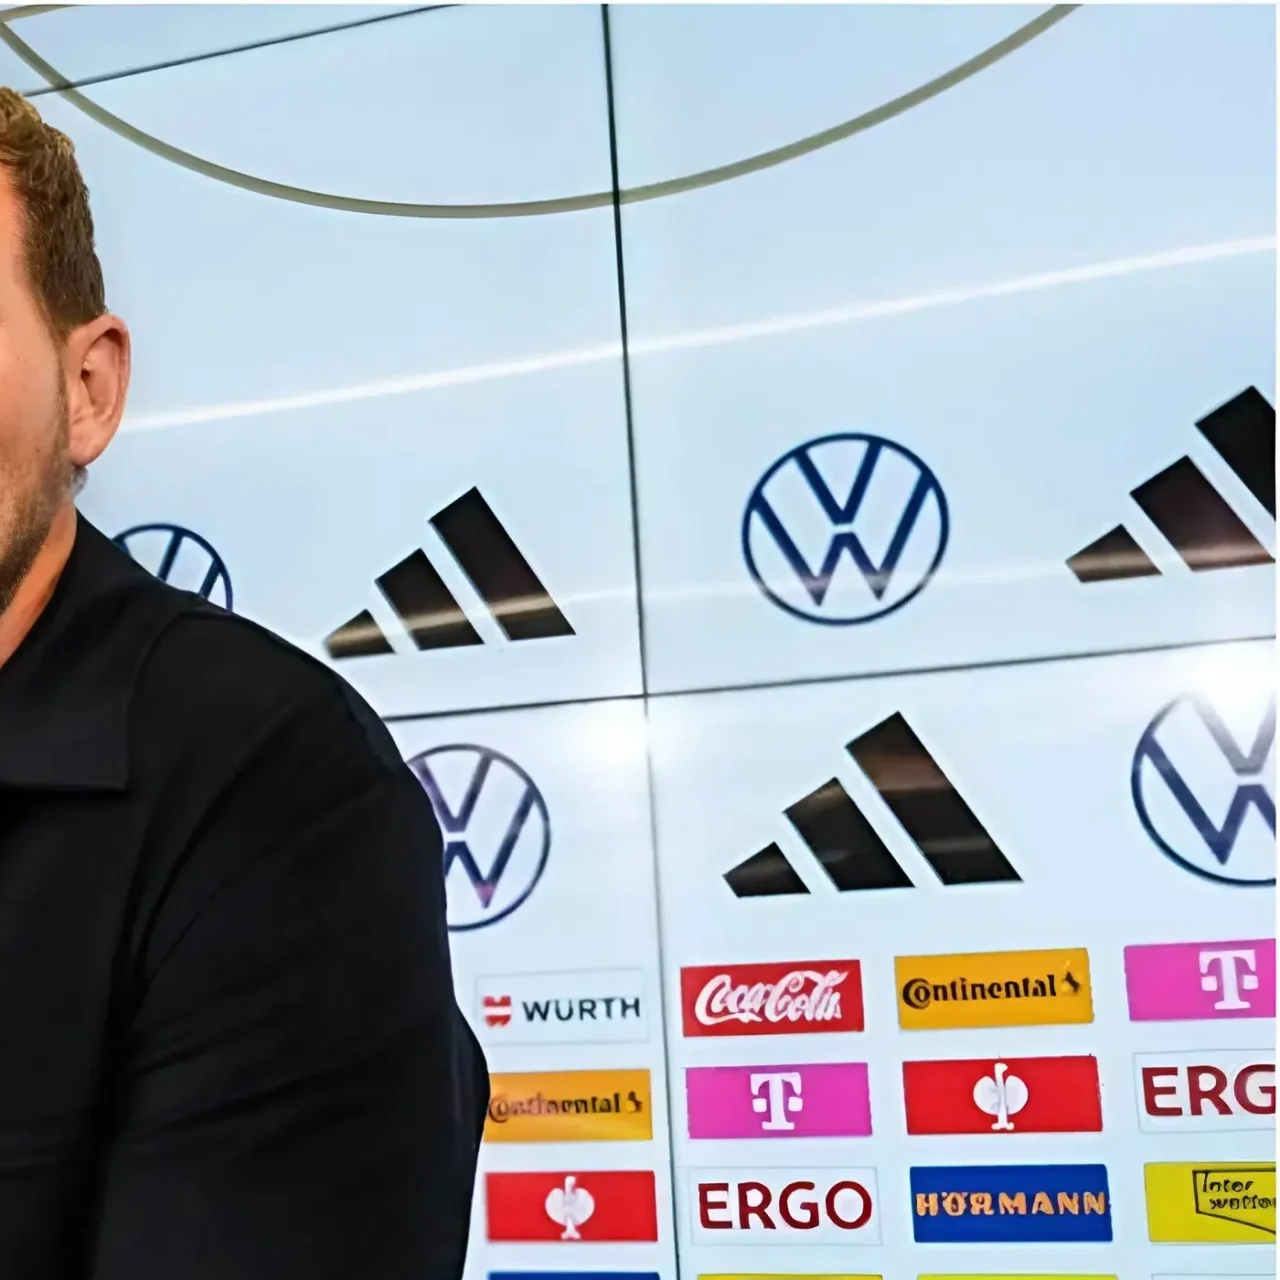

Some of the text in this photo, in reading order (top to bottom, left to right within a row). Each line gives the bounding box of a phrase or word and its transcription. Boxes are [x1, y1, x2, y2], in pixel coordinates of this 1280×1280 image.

[902, 974, 1057, 1010] Continental
[750, 1072, 803, 1130] T
[697, 1180, 873, 1231] ERGO
